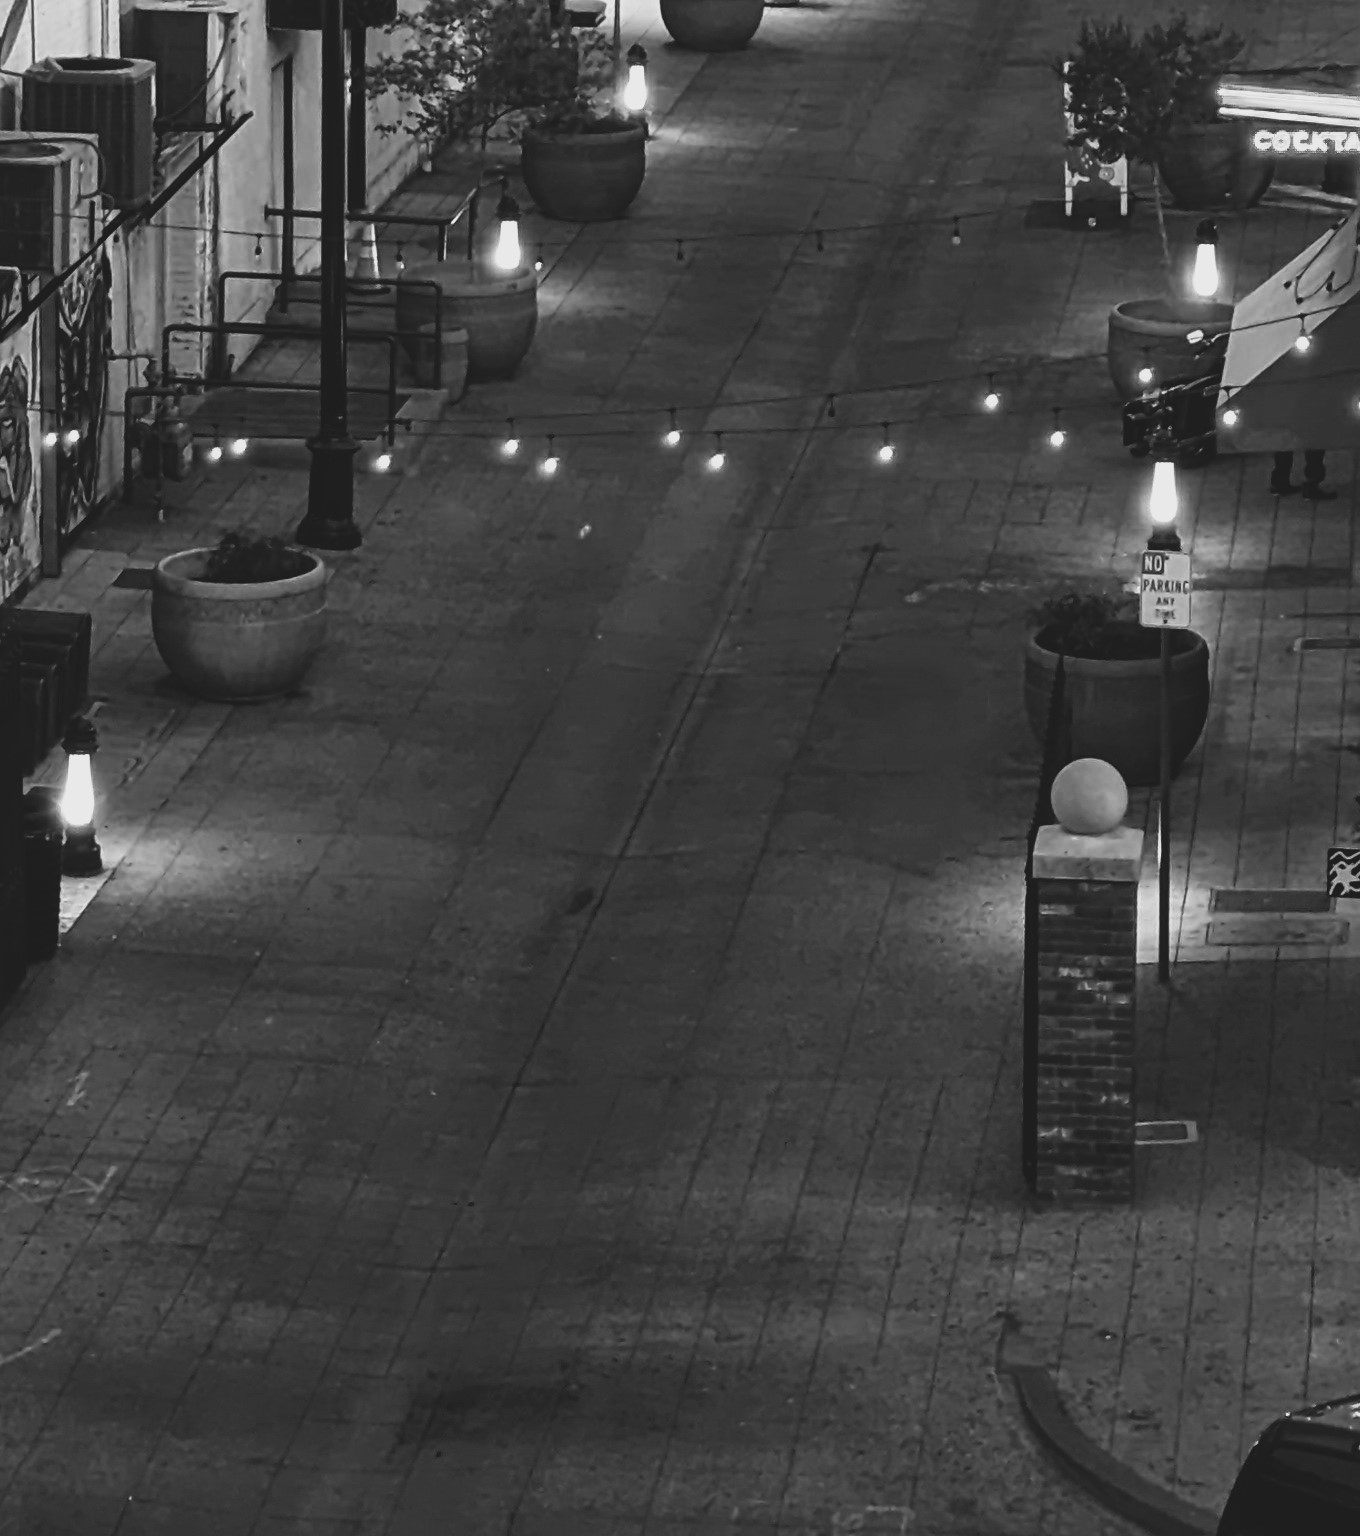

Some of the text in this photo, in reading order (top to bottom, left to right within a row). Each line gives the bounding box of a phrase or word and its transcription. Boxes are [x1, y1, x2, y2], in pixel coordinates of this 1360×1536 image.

[1144, 555, 1163, 572] NO
[1142, 578, 1189, 595] PARKING
[1155, 597, 1175, 606] ANY
